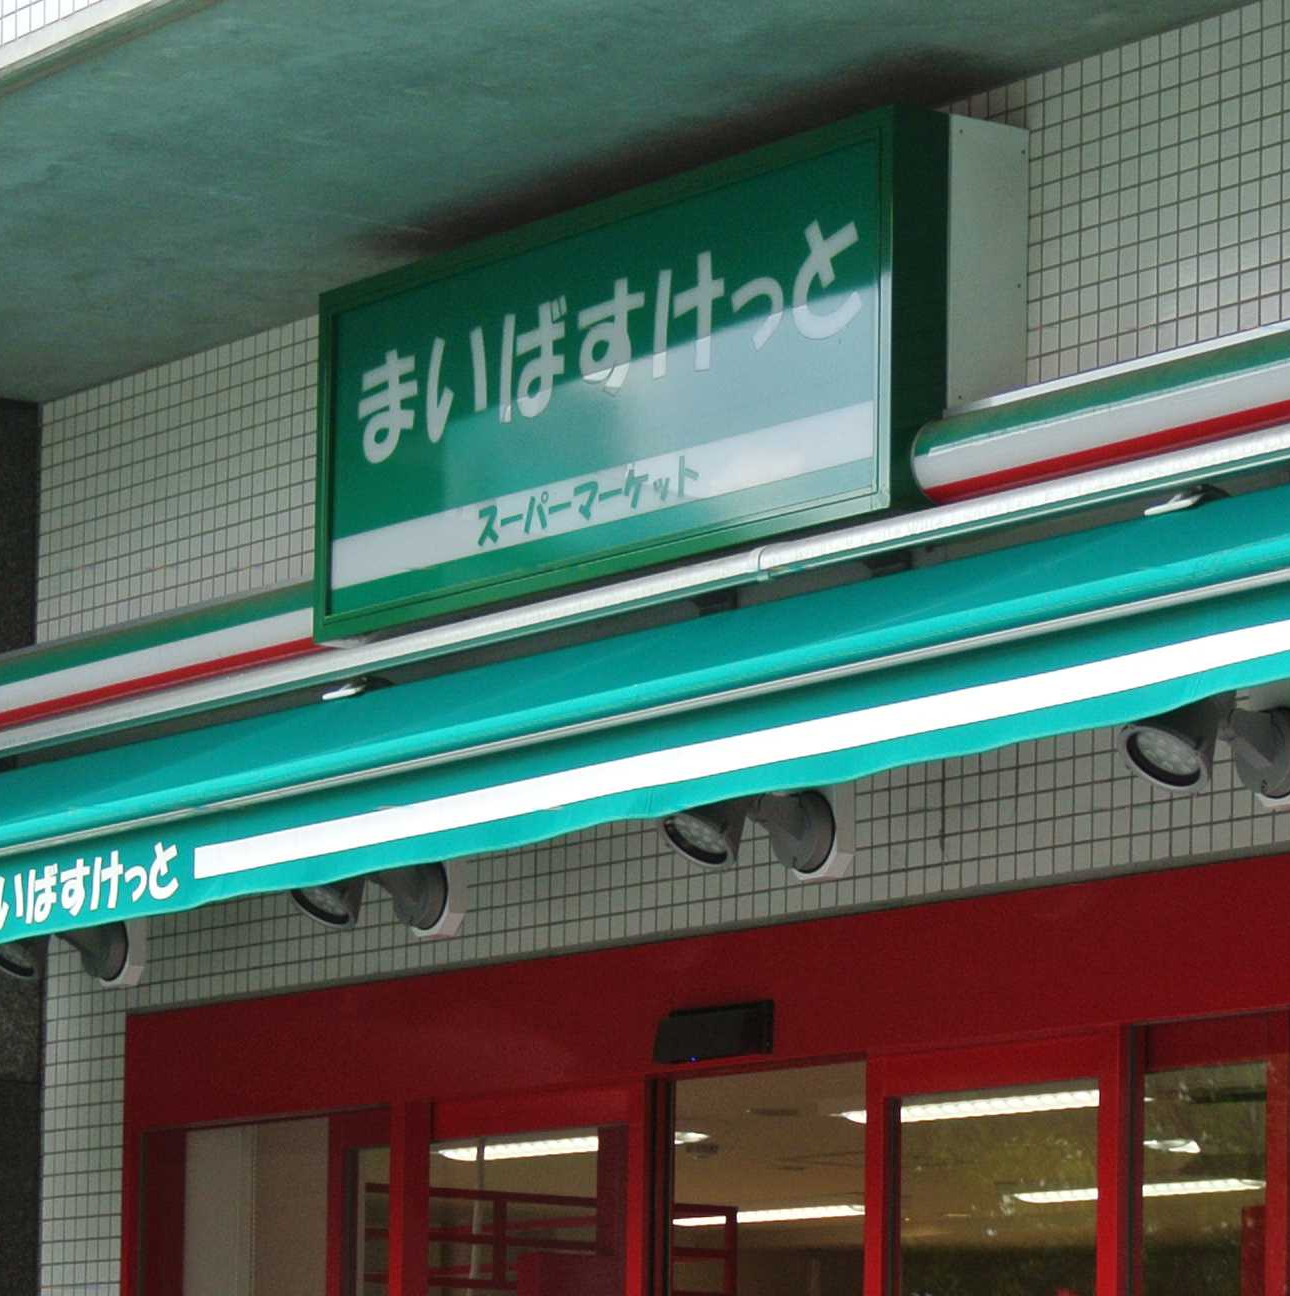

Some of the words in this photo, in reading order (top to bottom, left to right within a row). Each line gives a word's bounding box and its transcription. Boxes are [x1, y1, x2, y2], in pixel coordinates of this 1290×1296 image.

[358, 219, 862, 464] まいばすけっと
[477, 455, 699, 547] スーパーマーケット
